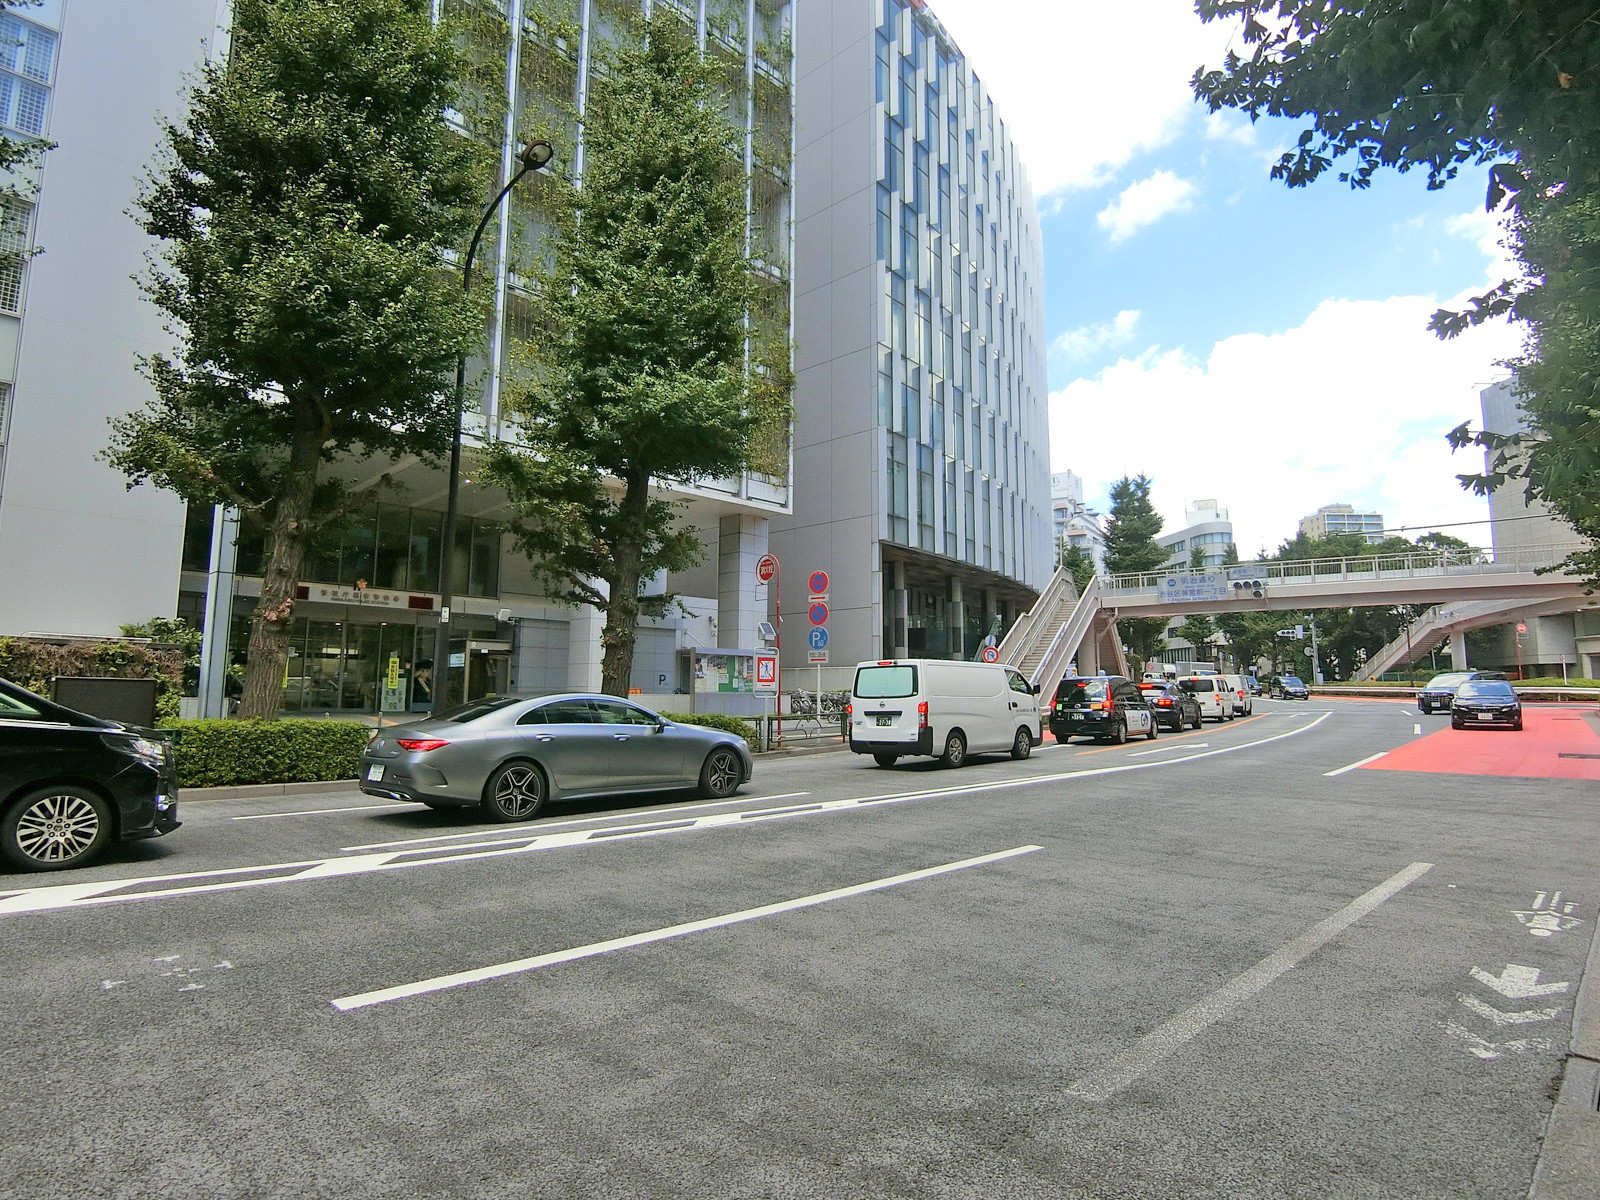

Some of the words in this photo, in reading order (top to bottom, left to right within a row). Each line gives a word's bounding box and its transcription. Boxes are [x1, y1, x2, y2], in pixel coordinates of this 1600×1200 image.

[760, 564, 774, 576] 消火栓
[1180, 575, 1215, 585] 明治通り
[1160, 587, 1227, 598] 渋谷区神宮前一丁目
[812, 632, 820, 646] P
[659, 674, 666, 685] P
